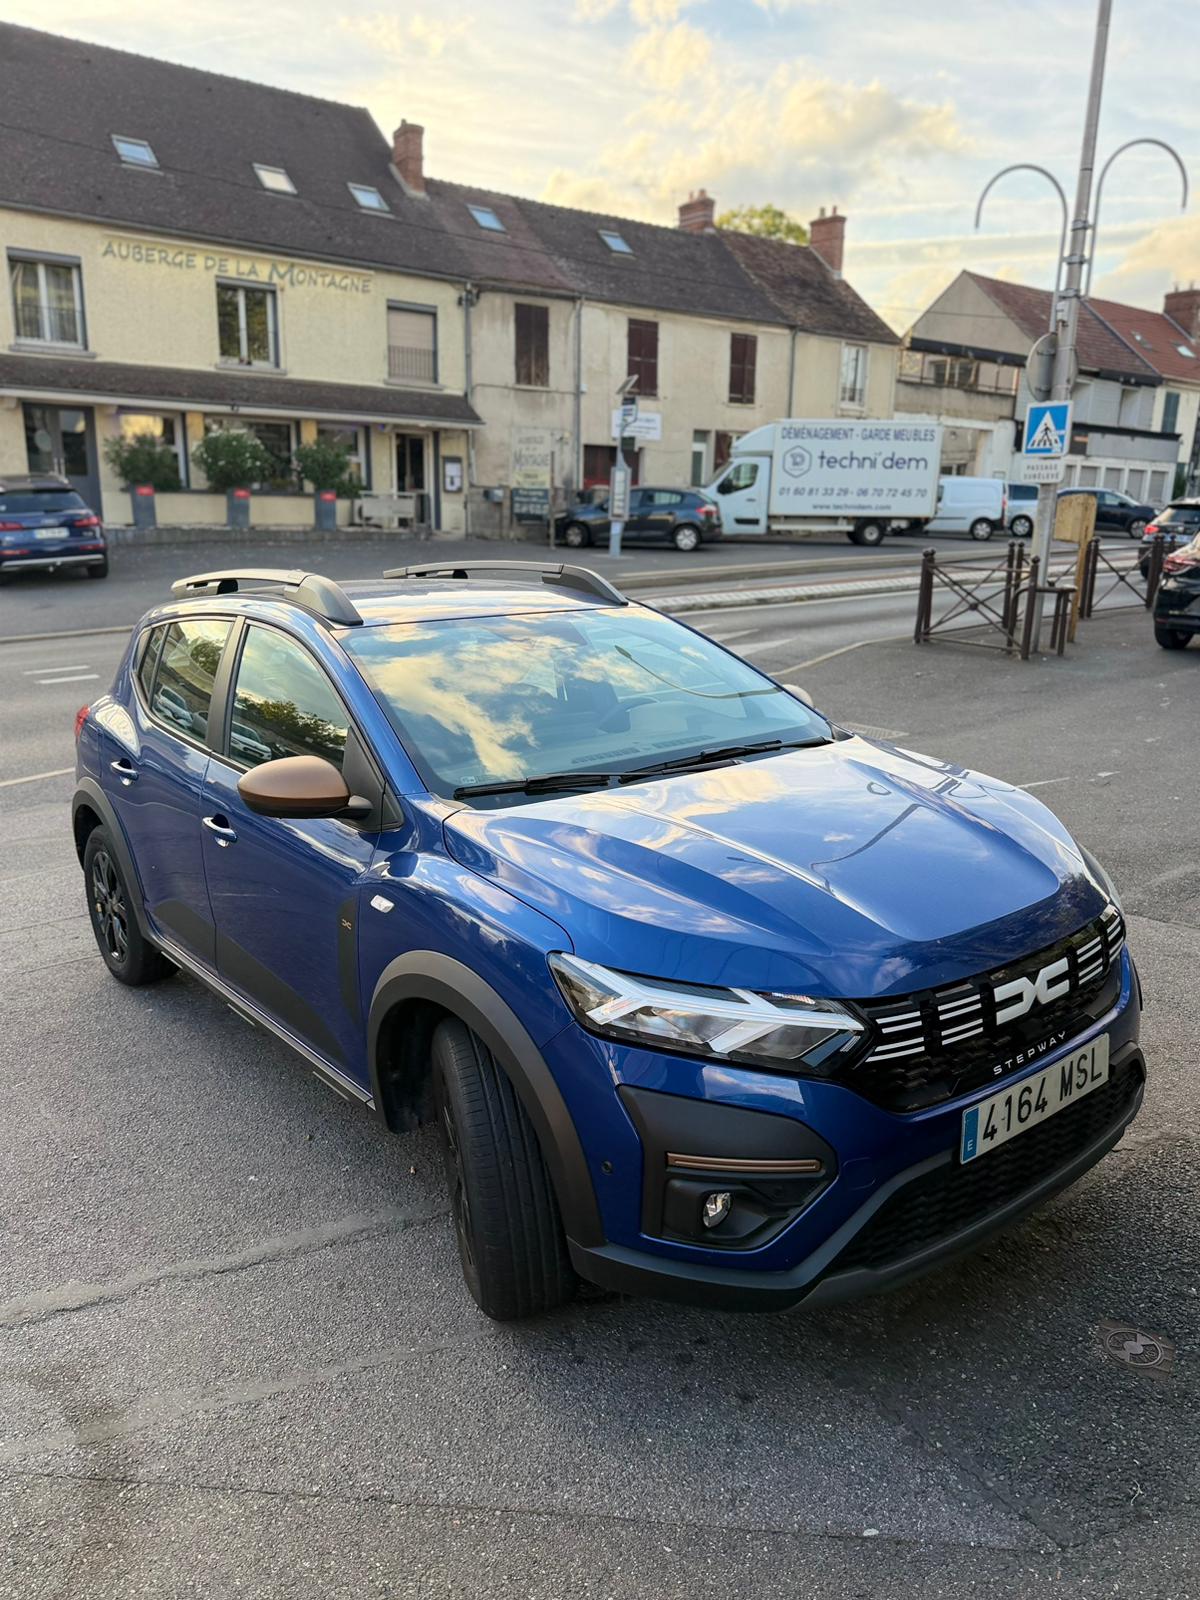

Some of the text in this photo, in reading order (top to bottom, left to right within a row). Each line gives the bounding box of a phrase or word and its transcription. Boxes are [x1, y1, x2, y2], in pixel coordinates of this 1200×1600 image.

[101, 241, 372, 294] AUBERGE DE LA MONTAGNE
[781, 425, 854, 440] DÉMÉNAGEMENT
[861, 428, 891, 441] GARDE
[893, 428, 936, 442] MEUBLES
[779, 487, 791, 497] 01
[992, 1030, 1067, 1076] STEPWAY
[967, 1047, 1103, 1151] E 4164 MSL
